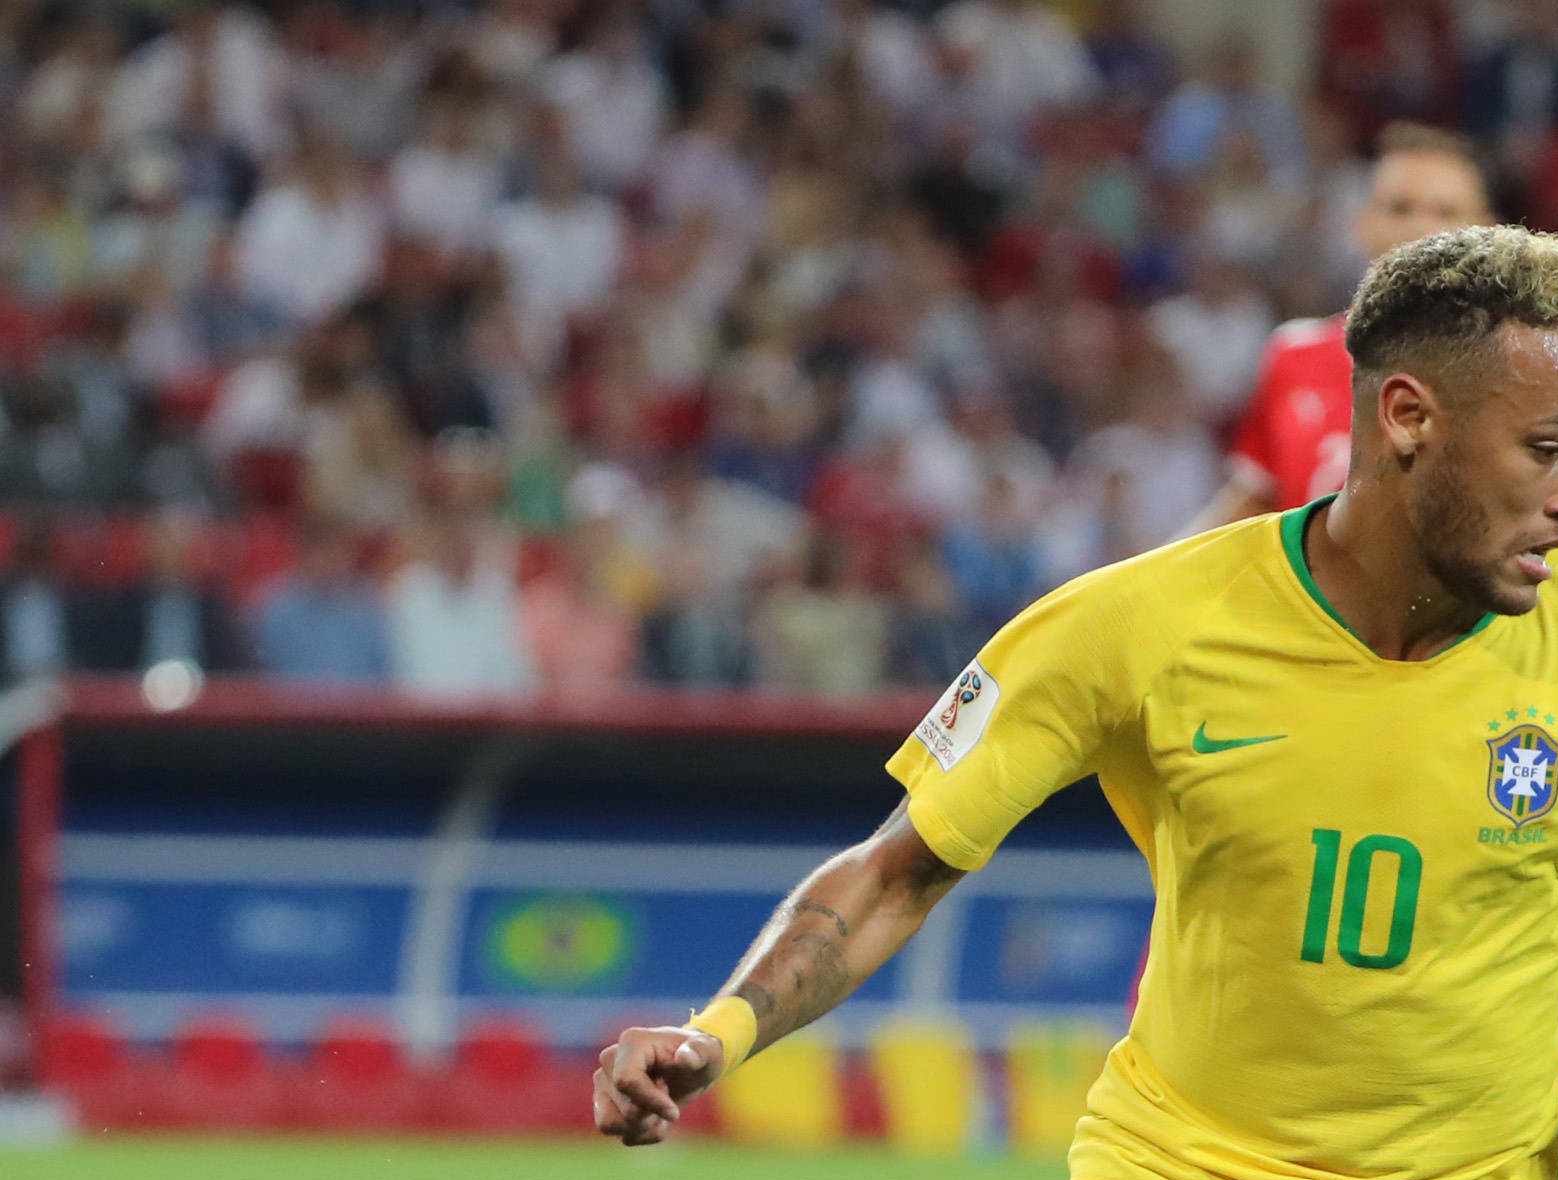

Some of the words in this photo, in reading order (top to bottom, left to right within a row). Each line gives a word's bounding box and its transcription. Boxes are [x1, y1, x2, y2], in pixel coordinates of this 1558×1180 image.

[1512, 765, 1538, 778] CBF
[1477, 827, 1546, 844] BRASIL
[1300, 828, 1423, 969] 10
